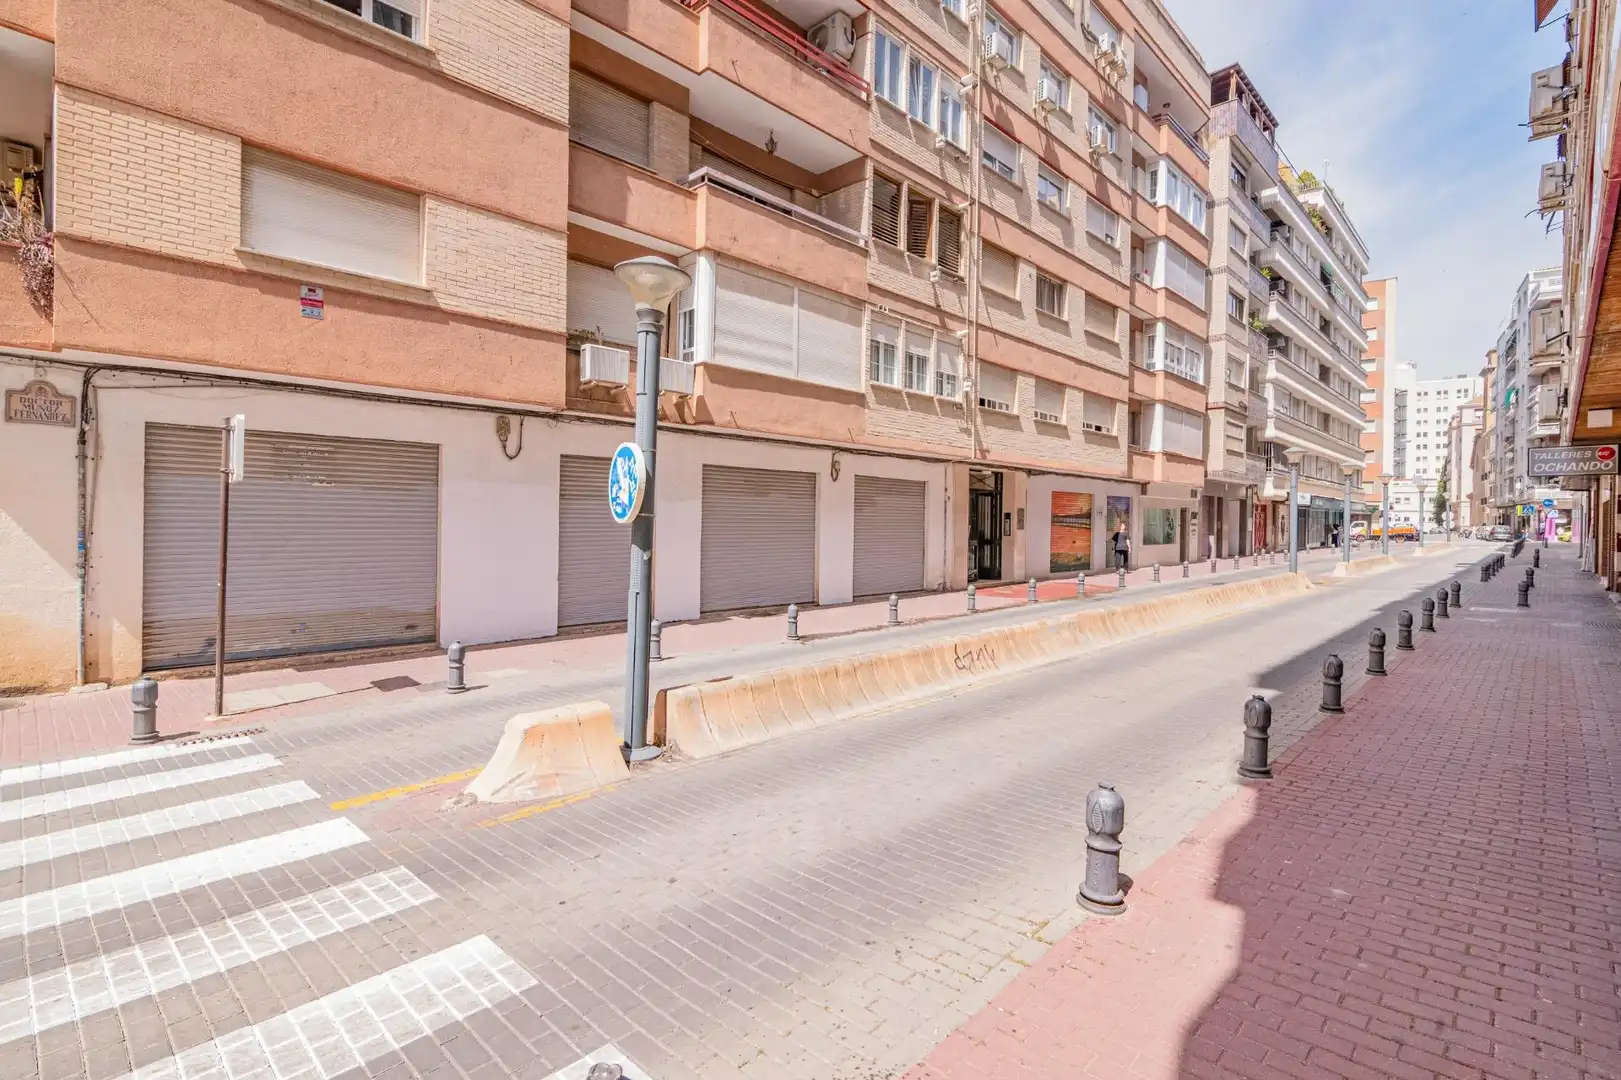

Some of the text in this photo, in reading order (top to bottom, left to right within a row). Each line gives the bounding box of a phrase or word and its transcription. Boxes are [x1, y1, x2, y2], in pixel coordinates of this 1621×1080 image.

[20, 397, 63, 407] DOCTOR
[1534, 451, 1592, 460] TALLERES
[1534, 461, 1613, 472] OCHANDO
